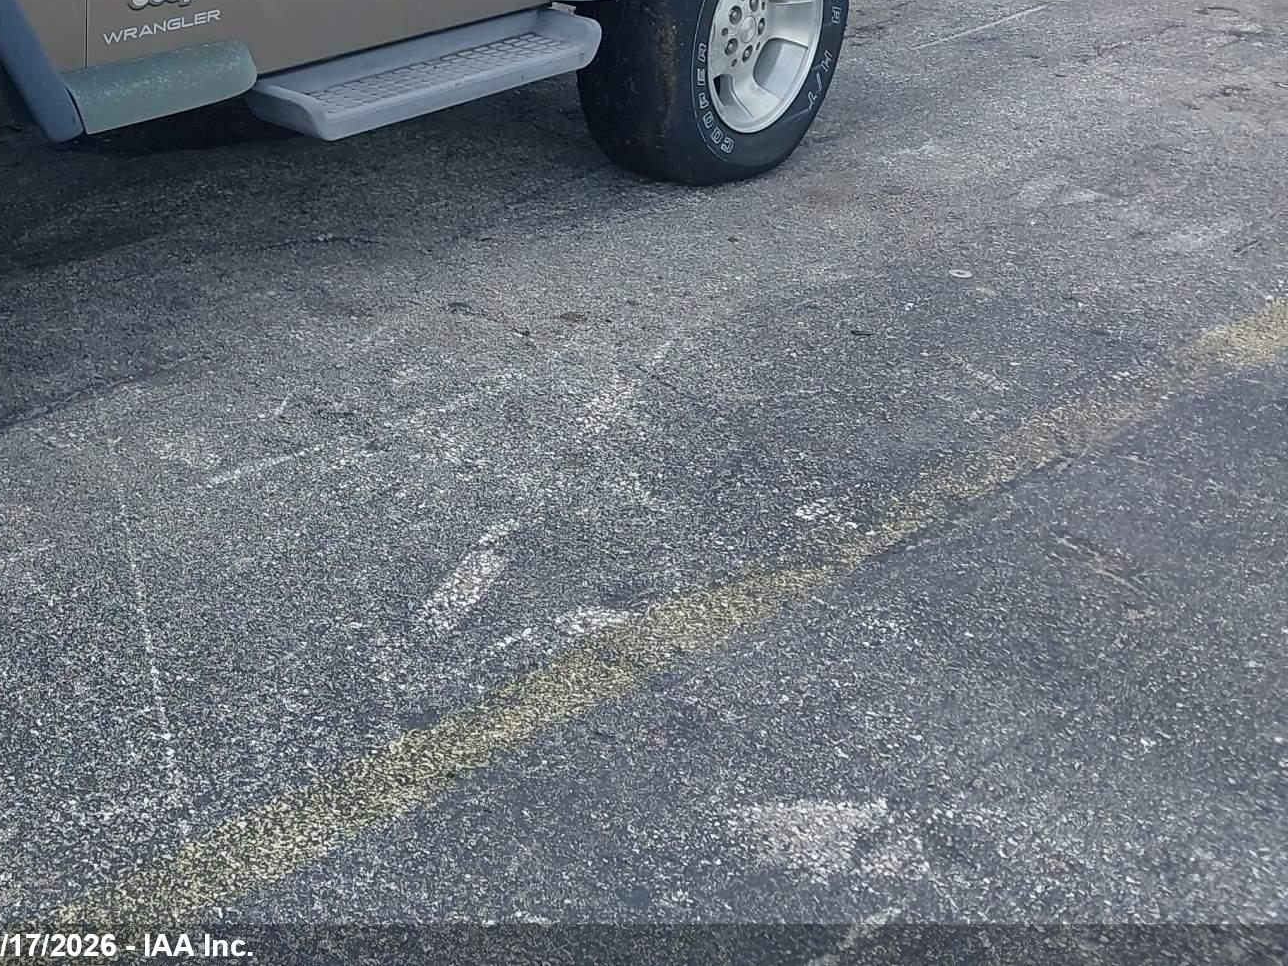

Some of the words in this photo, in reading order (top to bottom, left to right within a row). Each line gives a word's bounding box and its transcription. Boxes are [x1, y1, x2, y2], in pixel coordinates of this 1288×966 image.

[103, 9, 221, 45] WRANGLER
[697, 42, 734, 154] COOPER
[807, 48, 833, 111] H/T
